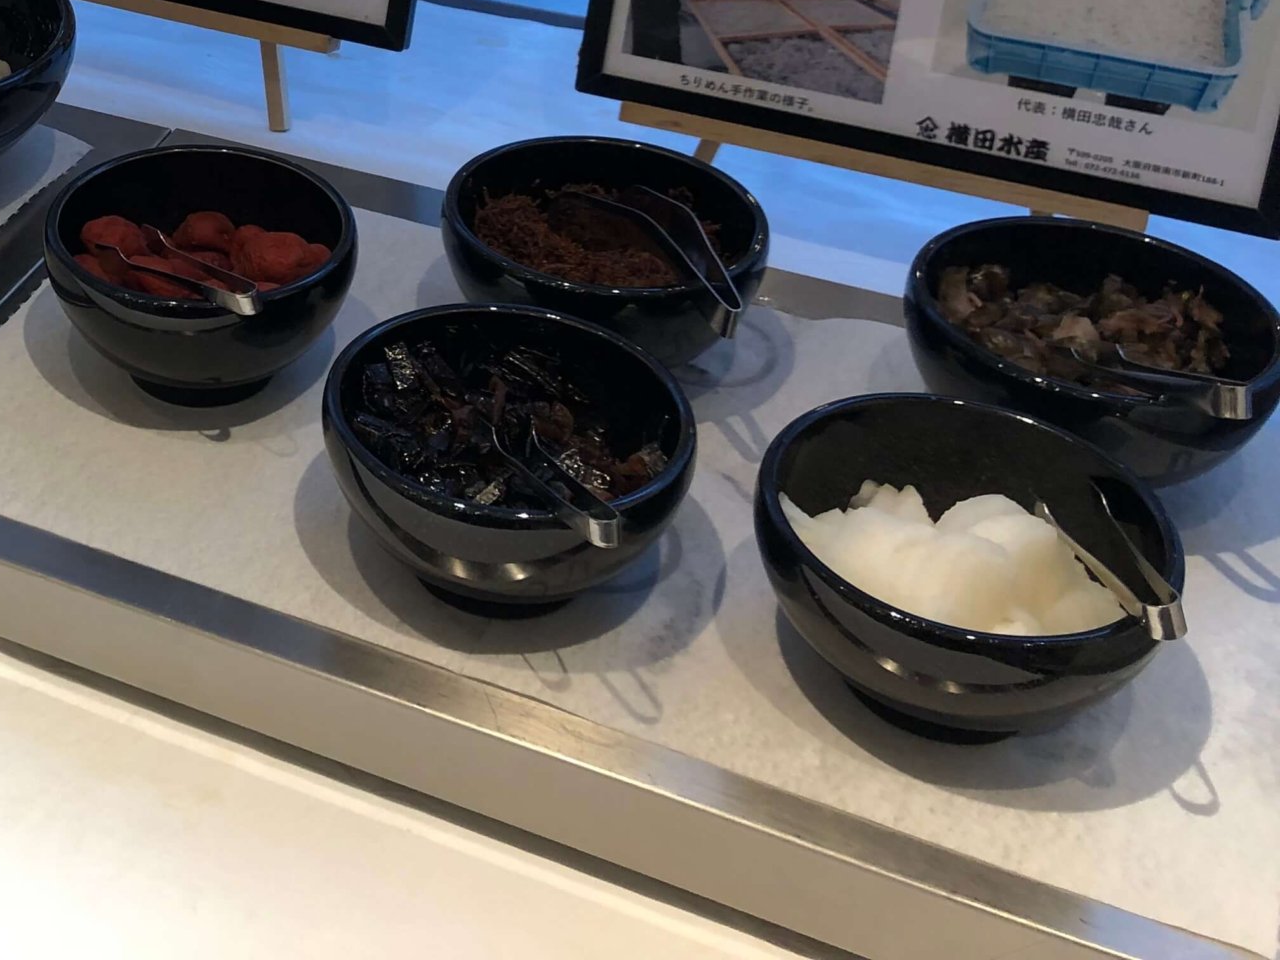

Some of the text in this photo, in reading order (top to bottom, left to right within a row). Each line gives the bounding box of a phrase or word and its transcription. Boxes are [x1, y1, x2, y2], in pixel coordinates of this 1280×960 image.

[679, 74, 813, 112] ちりめん手作業の様子。
[946, 121, 1051, 162] 横田水産
